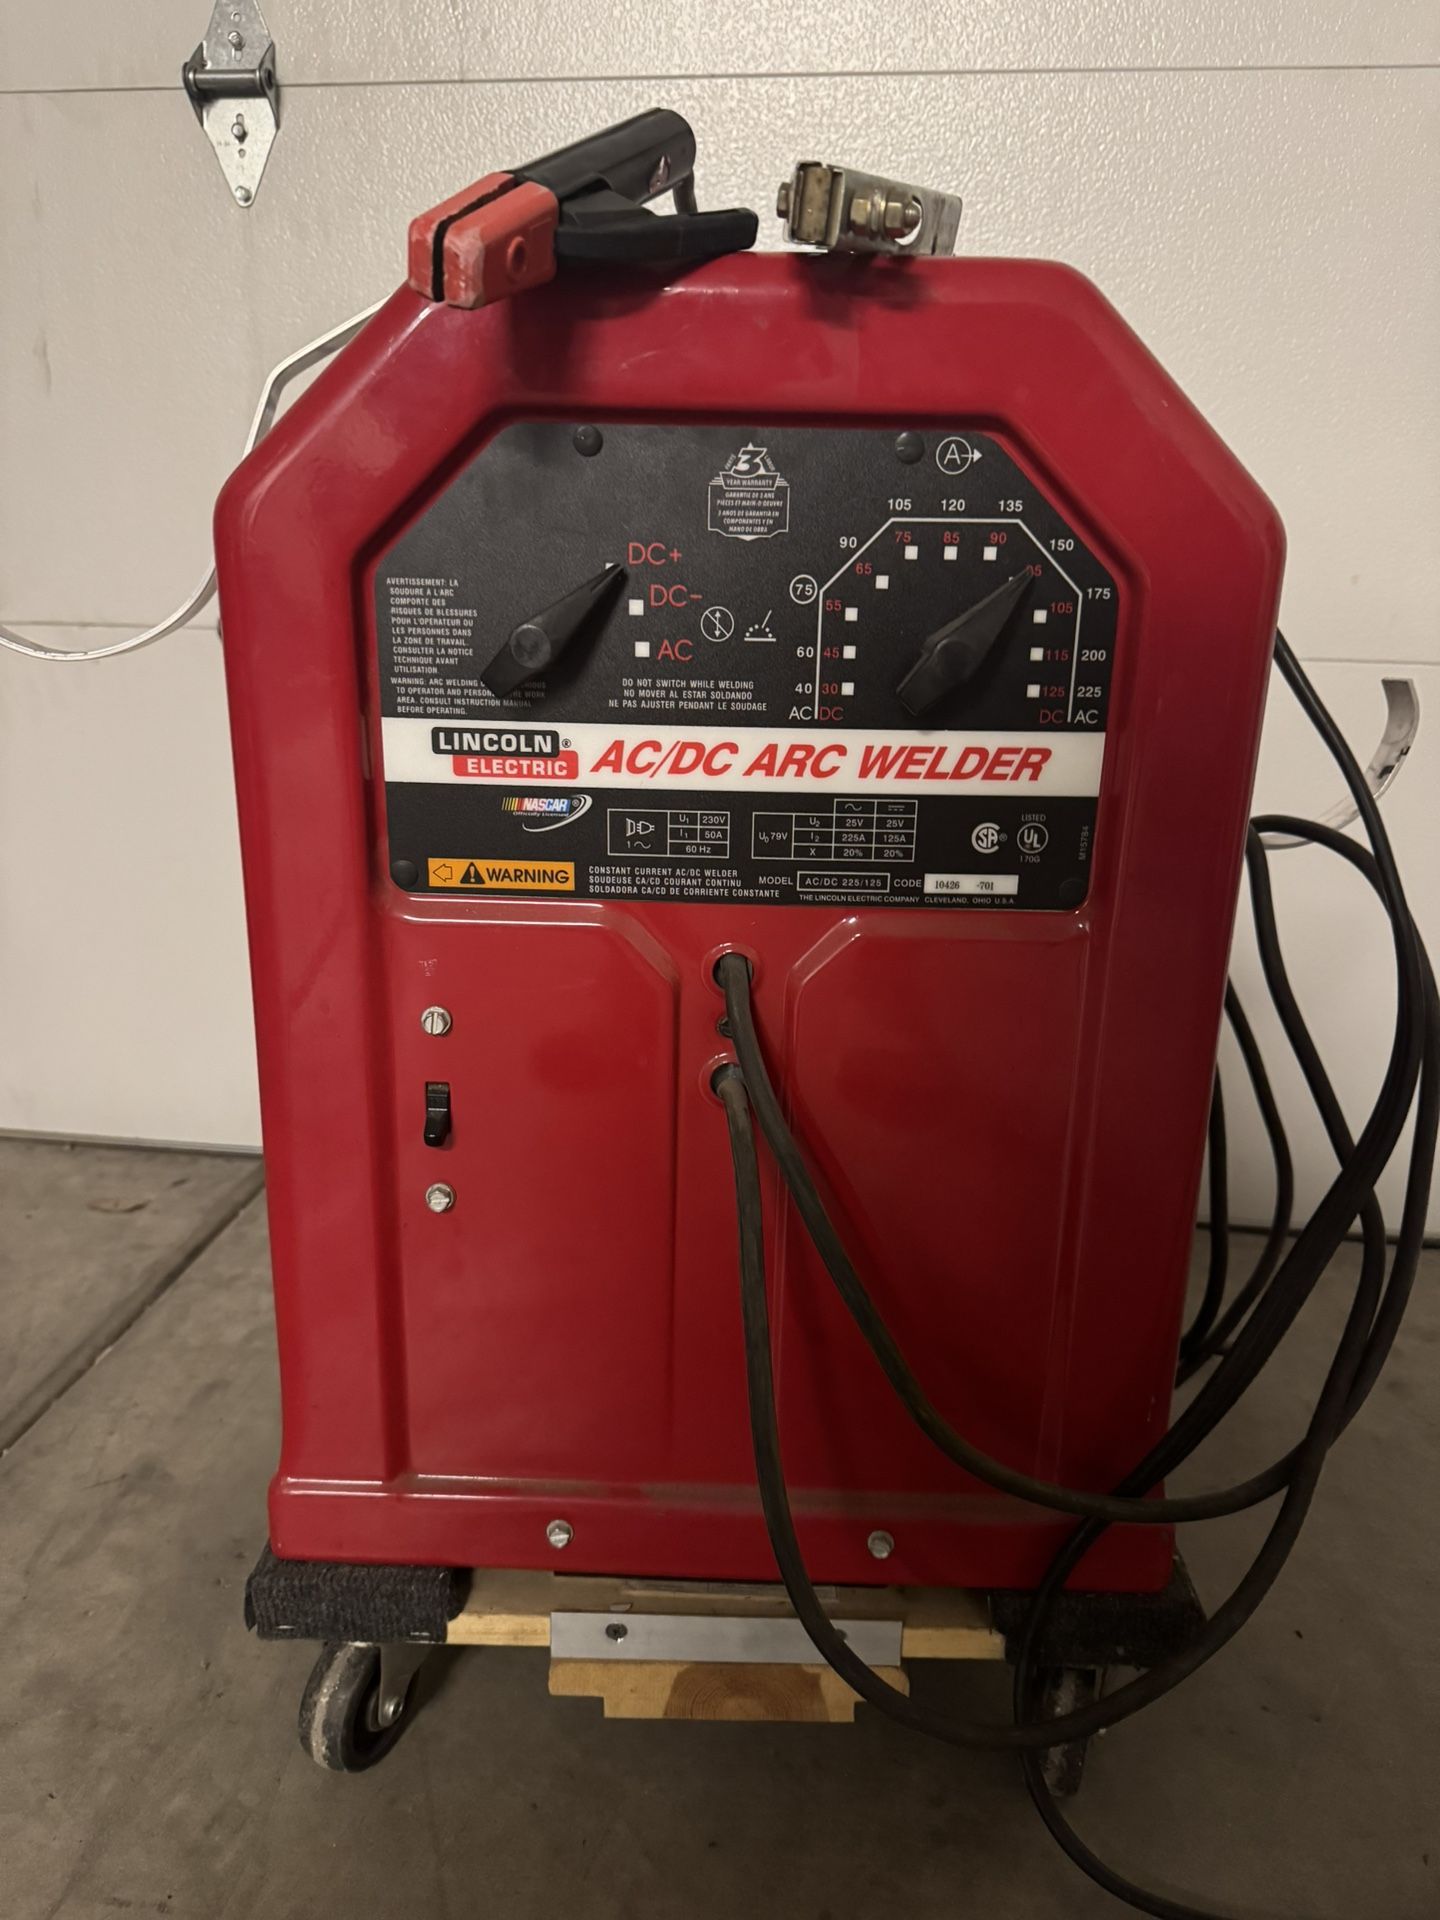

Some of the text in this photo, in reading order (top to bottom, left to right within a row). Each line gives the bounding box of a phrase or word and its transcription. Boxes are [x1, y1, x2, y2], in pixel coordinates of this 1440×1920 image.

[888, 499, 912, 511] 105
[941, 499, 965, 511] 120
[998, 500, 1023, 512] 135
[839, 537, 857, 549] 90
[895, 531, 912, 544] 75
[943, 531, 960, 544] 85
[989, 532, 1007, 544] 90
[1049, 539, 1074, 551] 150
[628, 542, 682, 565] DC+
[855, 562, 872, 575] 65
[449, 578, 459, 587] LA
[390, 587, 424, 596] SOUDURE
[649, 584, 703, 608] DC-
[795, 584, 813, 596] 75
[1086, 587, 1111, 600] 175
[390, 597, 446, 607] COMPORTE DES
[825, 600, 842, 612] 55
[1050, 602, 1073, 614] 105
[391, 607, 478, 617] RISQUES DE BLESSURES
[391, 616, 412, 625] POUR
[463, 619, 474, 627] OU
[392, 626, 472, 637] LES PERSONNES DANS
[392, 636, 402, 645] LA
[403, 636, 422, 645] ZONE
[424, 637, 434, 645] DE
[393, 646, 474, 657] CONSULTER LA NOTICE
[656, 639, 693, 661] AC
[796, 647, 814, 658] 60
[823, 647, 840, 658] 45
[1046, 649, 1069, 661] 115
[1081, 649, 1106, 661] 200
[393, 655, 459, 665] TECHNIQUE AVANT
[428, 677, 444, 686] ARC
[445, 678, 478, 687] WELDING
[622, 678, 754, 690] DO NOT SWITCH WHILE WELDING
[396, 686, 406, 695] TO
[407, 686, 445, 695] OPERATOR
[446, 688, 462, 696] AND
[623, 688, 753, 700] NO MOVER AL ESTAR SOLDANDO
[795, 683, 813, 694] 40
[821, 683, 838, 694] 30
[1042, 686, 1065, 697] 125
[1077, 686, 1102, 698] 225
[419, 696, 451, 705] CONSULT
[453, 697, 501, 707] INSTRUCTION
[502, 699, 532, 708] MANUAL
[608, 699, 767, 711] NE PAS AJUSTER PENDANT LE SOUDAGE
[397, 706, 424, 714] BEFORE
[788, 706, 812, 720] AC
[819, 707, 844, 720] DC
[1040, 709, 1064, 723] DC
[1074, 709, 1098, 723] AC
[438, 731, 552, 753] LINCOLN
[467, 757, 568, 776] ELECTRIC
[590, 739, 1053, 782] AC/DC ARC WELDER
[522, 797, 568, 811] NASCAR
[702, 814, 726, 824] 230V
[845, 818, 864, 828] 25V
[886, 818, 905, 828] 25V
[1021, 814, 1046, 822] LISTED
[704, 831, 723, 840] 50A
[841, 833, 866, 843] 225A
[883, 834, 906, 844] 125A
[685, 845, 711, 855] 60 Hz
[809, 848, 903, 858] X 20% 20%
[486, 866, 570, 885] WARNING
[589, 865, 738, 878] CONSTANT CURRENT AC/DC WELDER
[589, 876, 742, 887] SOUDEUSE CA/CD COURANT CONTINU
[758, 876, 793, 885] MODEL
[805, 877, 838, 887] AC/DC
[842, 878, 882, 888] 225/125
[893, 878, 922, 888] CODE
[935, 880, 960, 890] 10426
[589, 885, 780, 898] SOLDADORA CA/CD DE CORRIENTE CONSTANTE
[814, 894, 846, 902] LINCOLN
[847, 895, 882, 903] ELECTRIC
[883, 896, 920, 904] COMPANY
